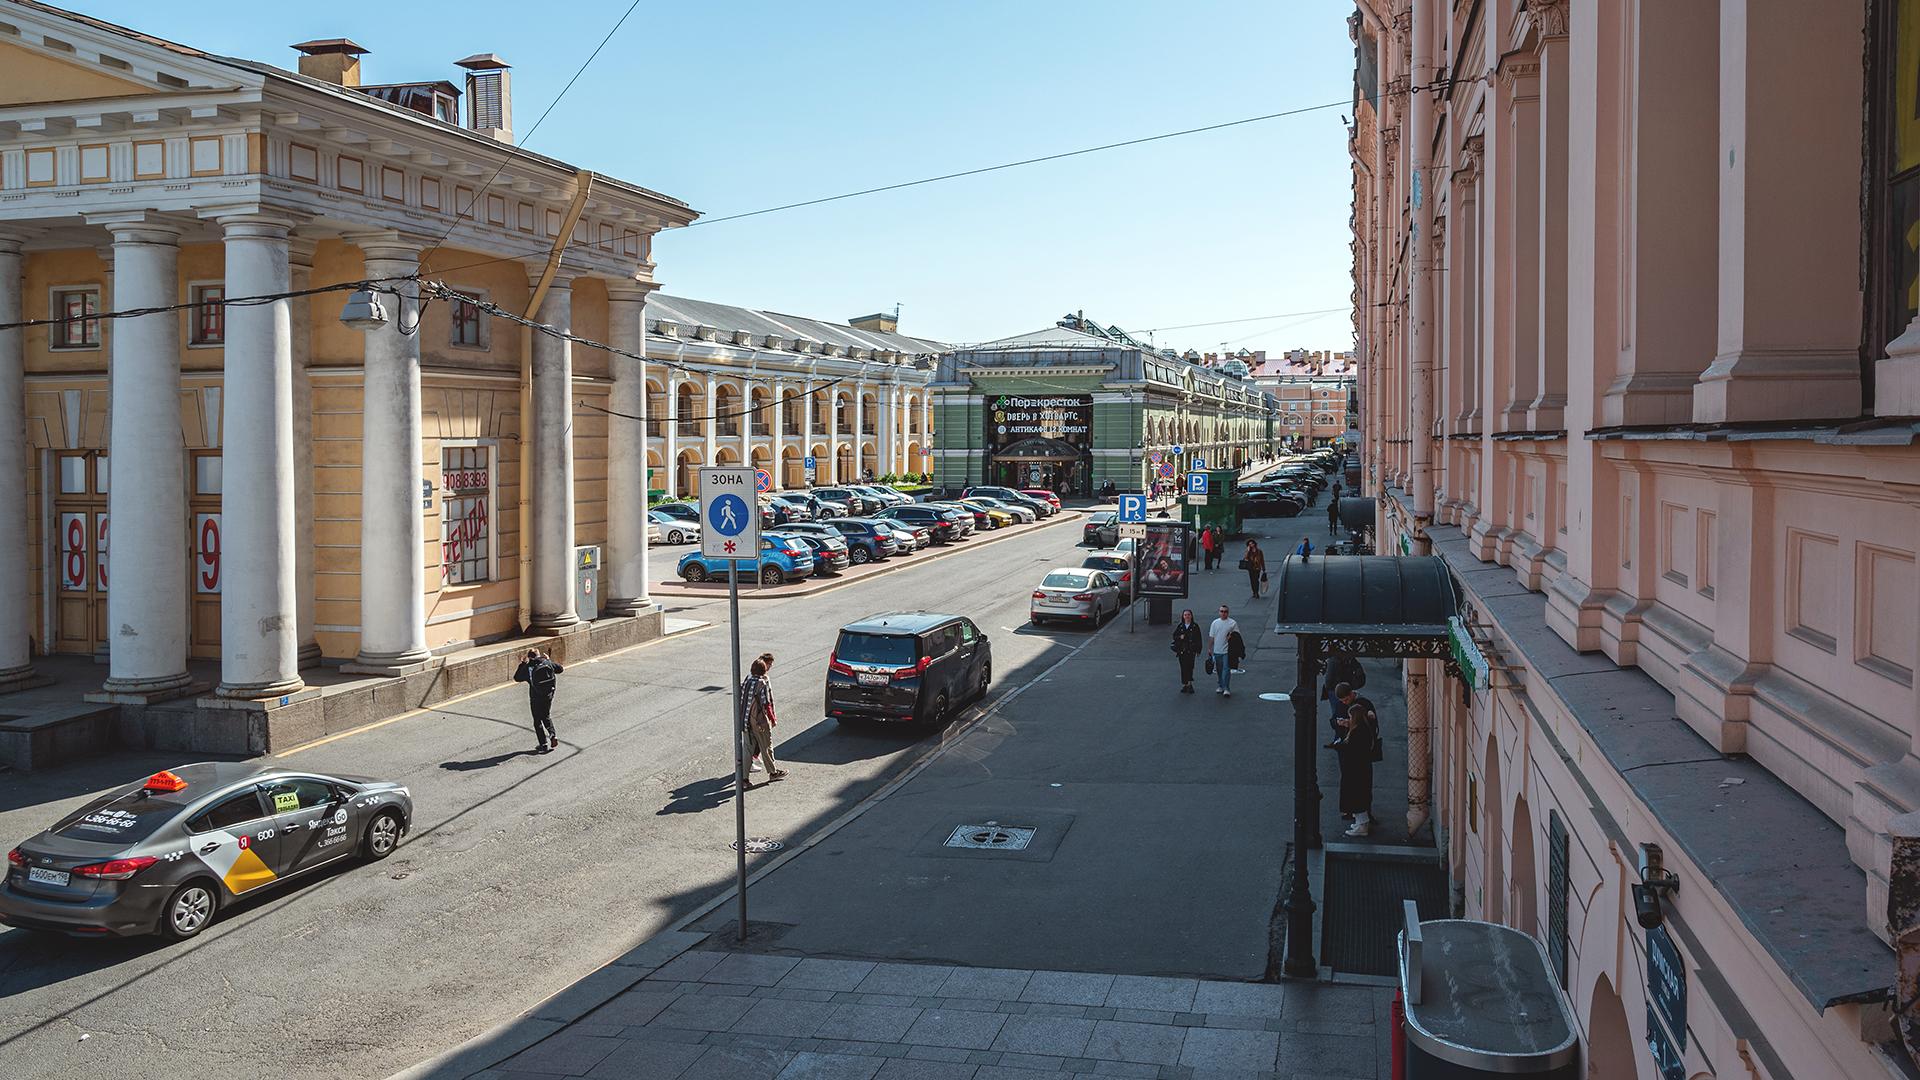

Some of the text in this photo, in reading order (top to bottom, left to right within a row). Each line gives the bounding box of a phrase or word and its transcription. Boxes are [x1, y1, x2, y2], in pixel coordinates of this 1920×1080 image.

[712, 474, 743, 485] ЗОНА
[277, 795, 296, 804] TAXI
[308, 812, 346, 830] Яндекс Go
[257, 828, 275, 841] 600
[326, 826, 347, 837] Такси
[240, 837, 248, 848] Я
